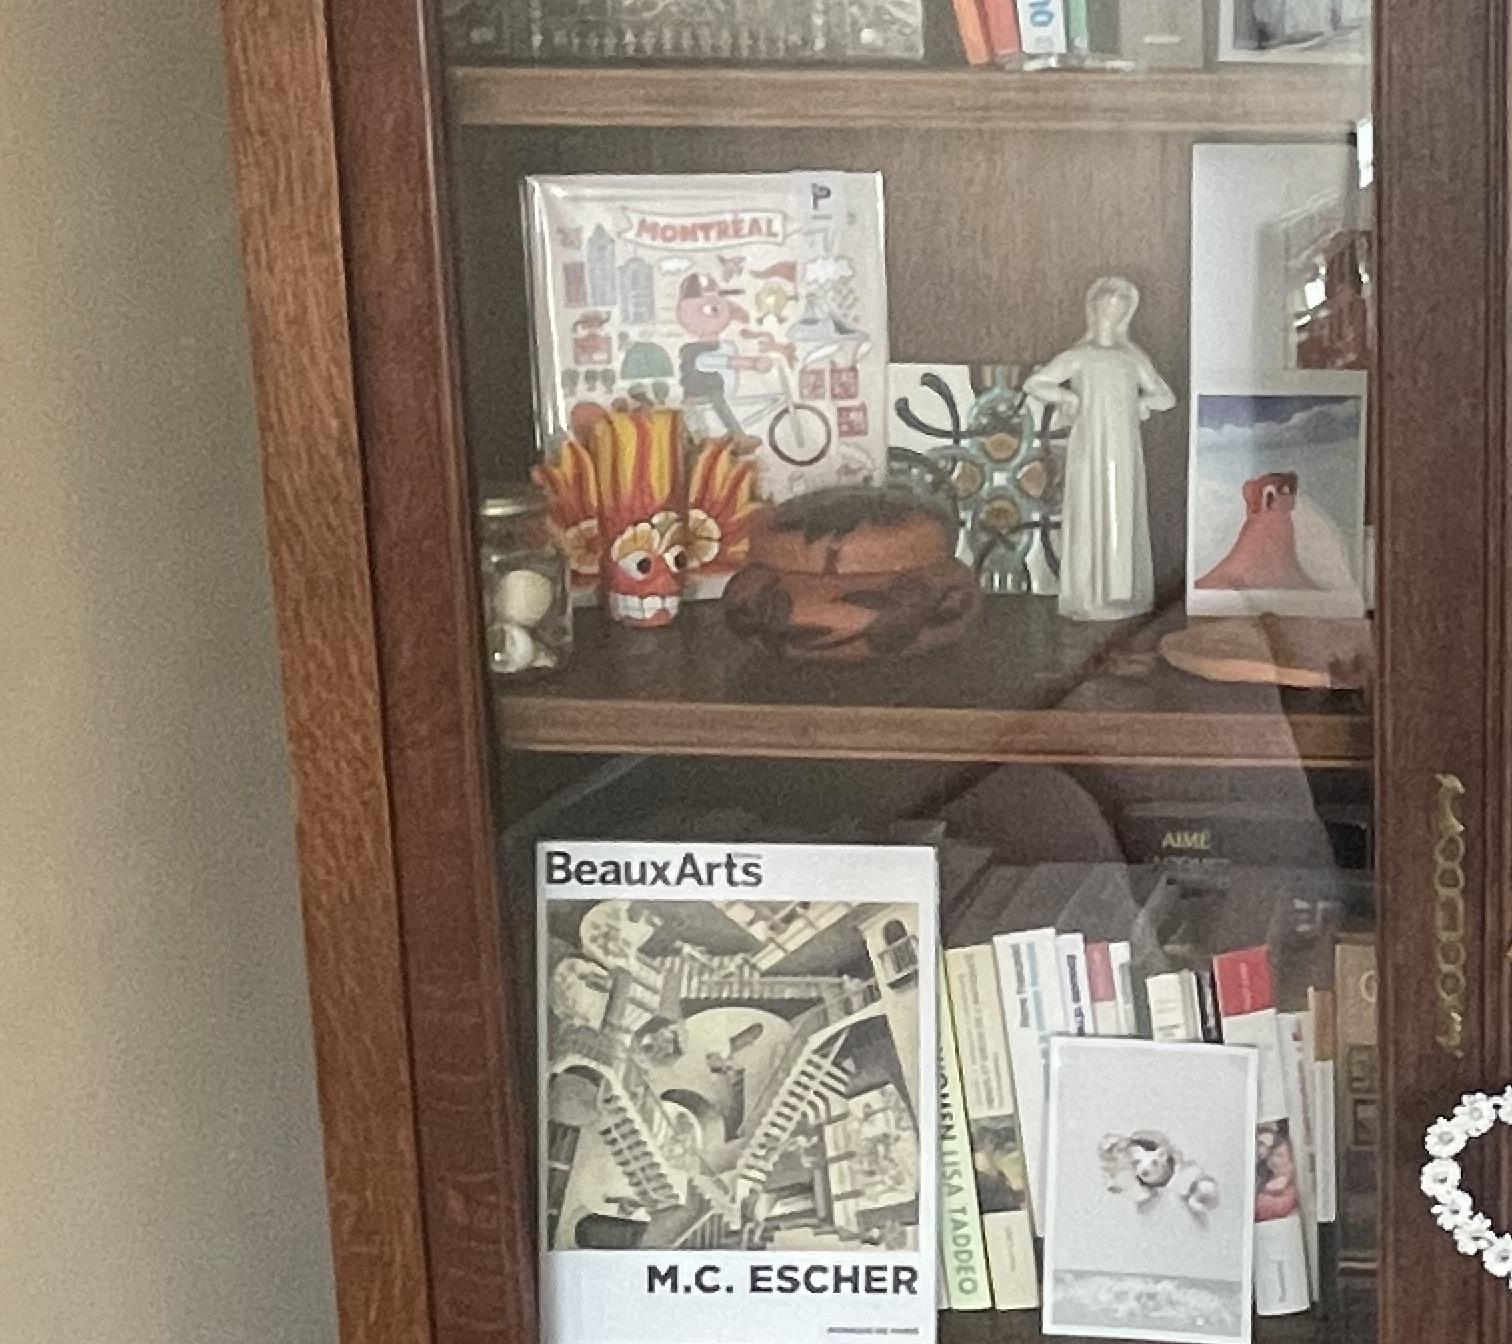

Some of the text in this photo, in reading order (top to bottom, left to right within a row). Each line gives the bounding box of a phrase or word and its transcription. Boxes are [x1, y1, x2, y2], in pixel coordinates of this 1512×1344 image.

[544, 850, 763, 888] BeauxArts
[941, 1150, 964, 1198] LISA
[950, 1205, 978, 1297] TADDEO
[646, 1264, 919, 1295] M.C. ESCHER
